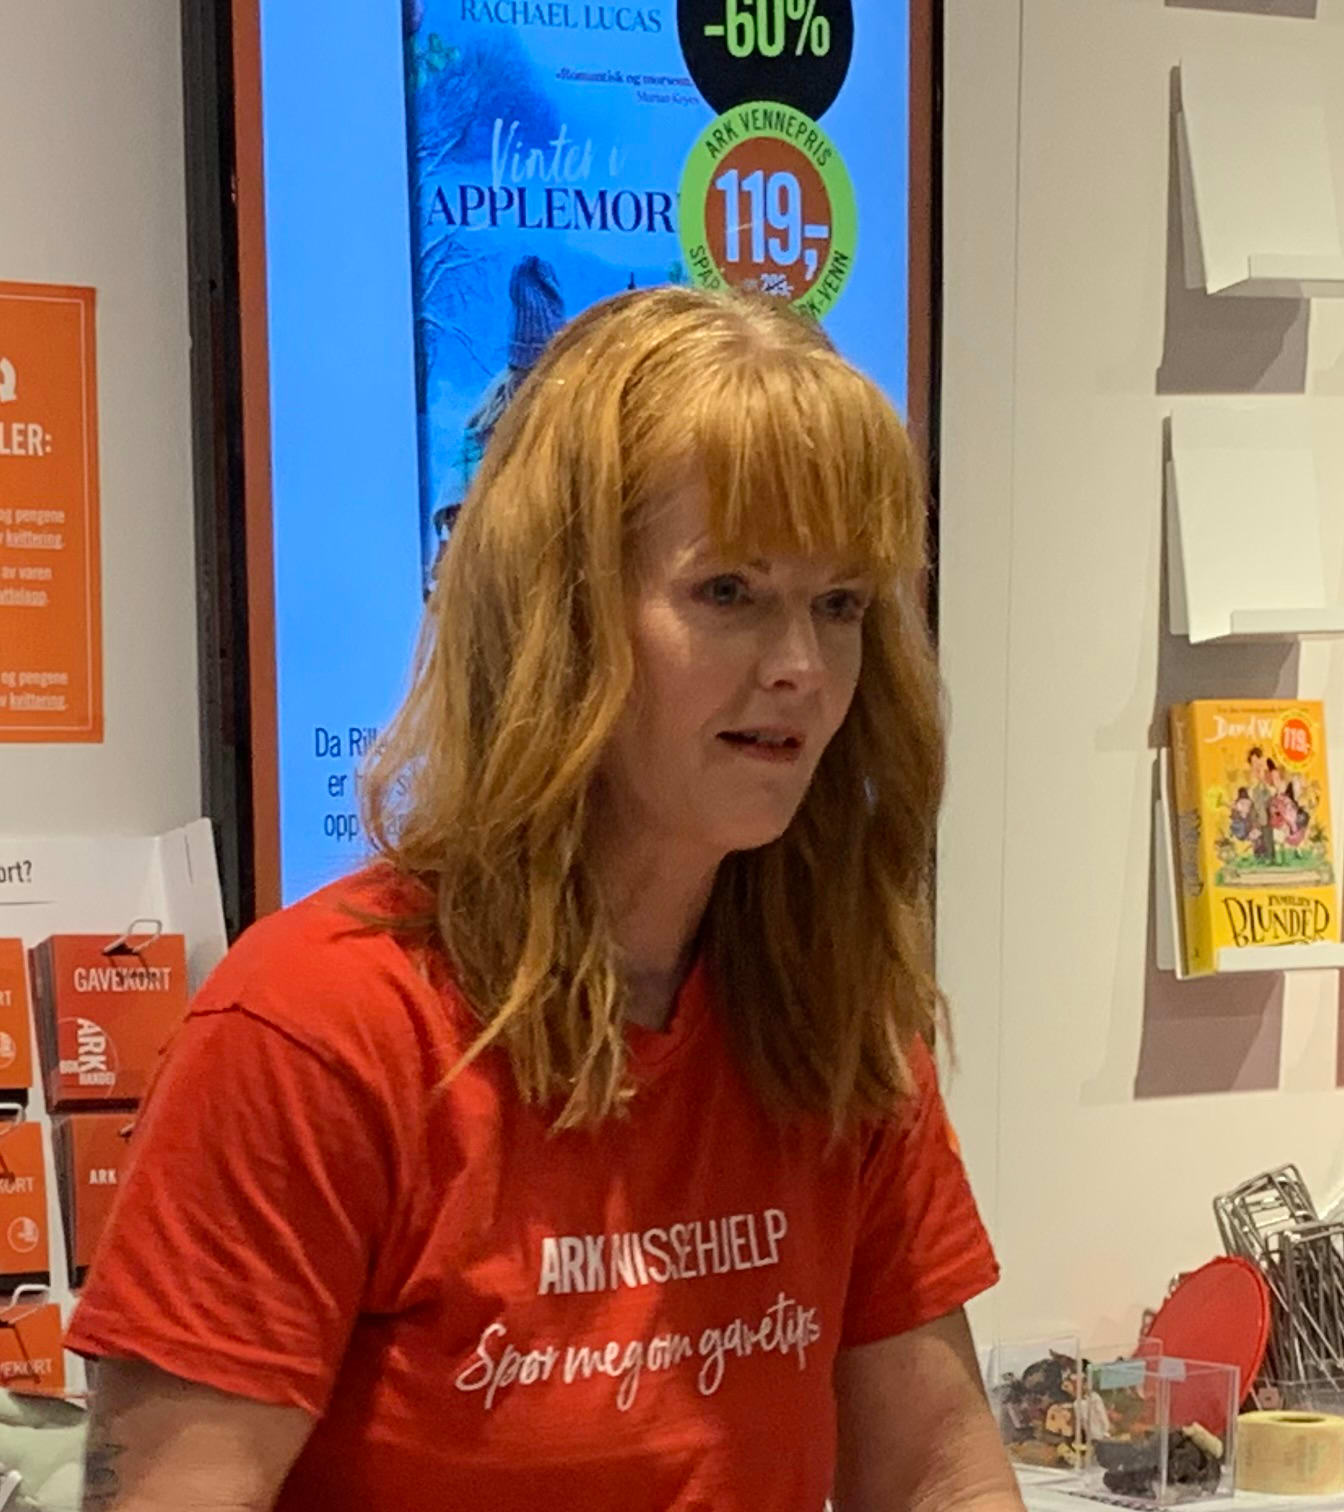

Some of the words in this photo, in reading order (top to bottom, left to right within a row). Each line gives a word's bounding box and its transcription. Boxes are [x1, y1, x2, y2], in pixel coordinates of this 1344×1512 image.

[585, 5, 663, 33] LUCAS
[704, 0, 830, 58] -60%
[491, 117, 593, 193] Vinter
[705, 119, 739, 159] ARK
[739, 108, 832, 167] VENNEPRIS
[426, 184, 681, 233] APPLEMOR
[715, 168, 830, 281] 119,-
[315, 727, 342, 757] Da
[328, 774, 347, 797] er
[74, 965, 171, 994] GAVEKORT
[76, 1018, 108, 1077] ARK
[89, 1169, 117, 1185] ARK
[538, 1237, 606, 1295] ARK
[456, 1323, 558, 1409] Spor
[563, 1340, 647, 1411] meg
